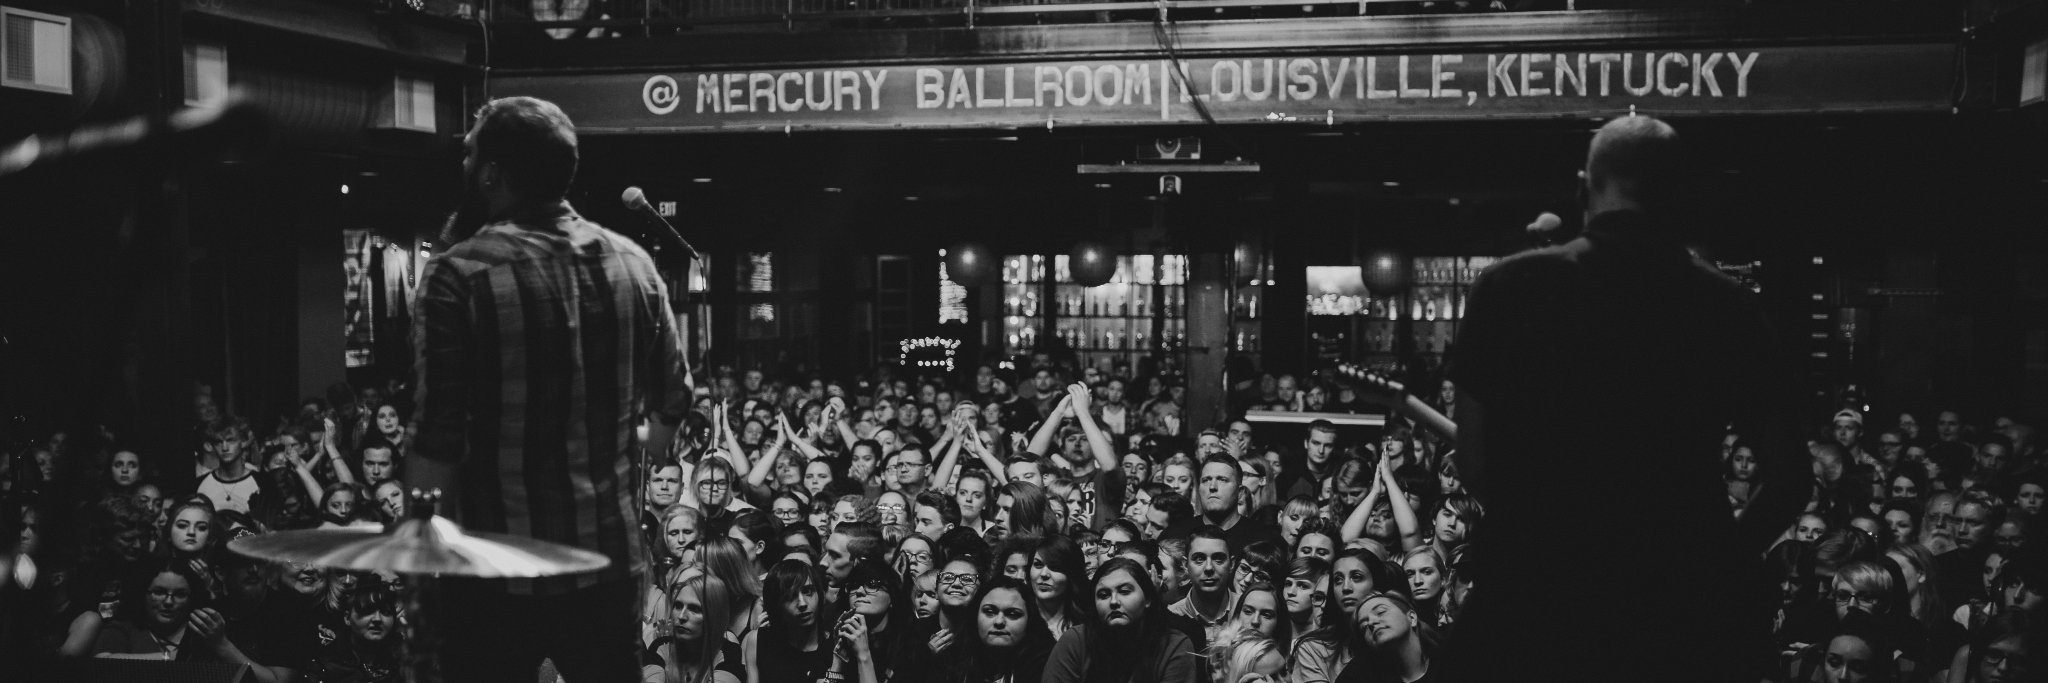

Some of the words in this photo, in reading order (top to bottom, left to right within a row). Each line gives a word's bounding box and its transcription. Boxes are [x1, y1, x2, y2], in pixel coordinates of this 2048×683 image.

[642, 74, 680, 115] @
[696, 69, 888, 113] MERCURY
[916, 63, 1152, 109] BALLROOM
[1180, 54, 1477, 106] LOUISVILLE,
[1487, 51, 1760, 98] KENTUCKY
